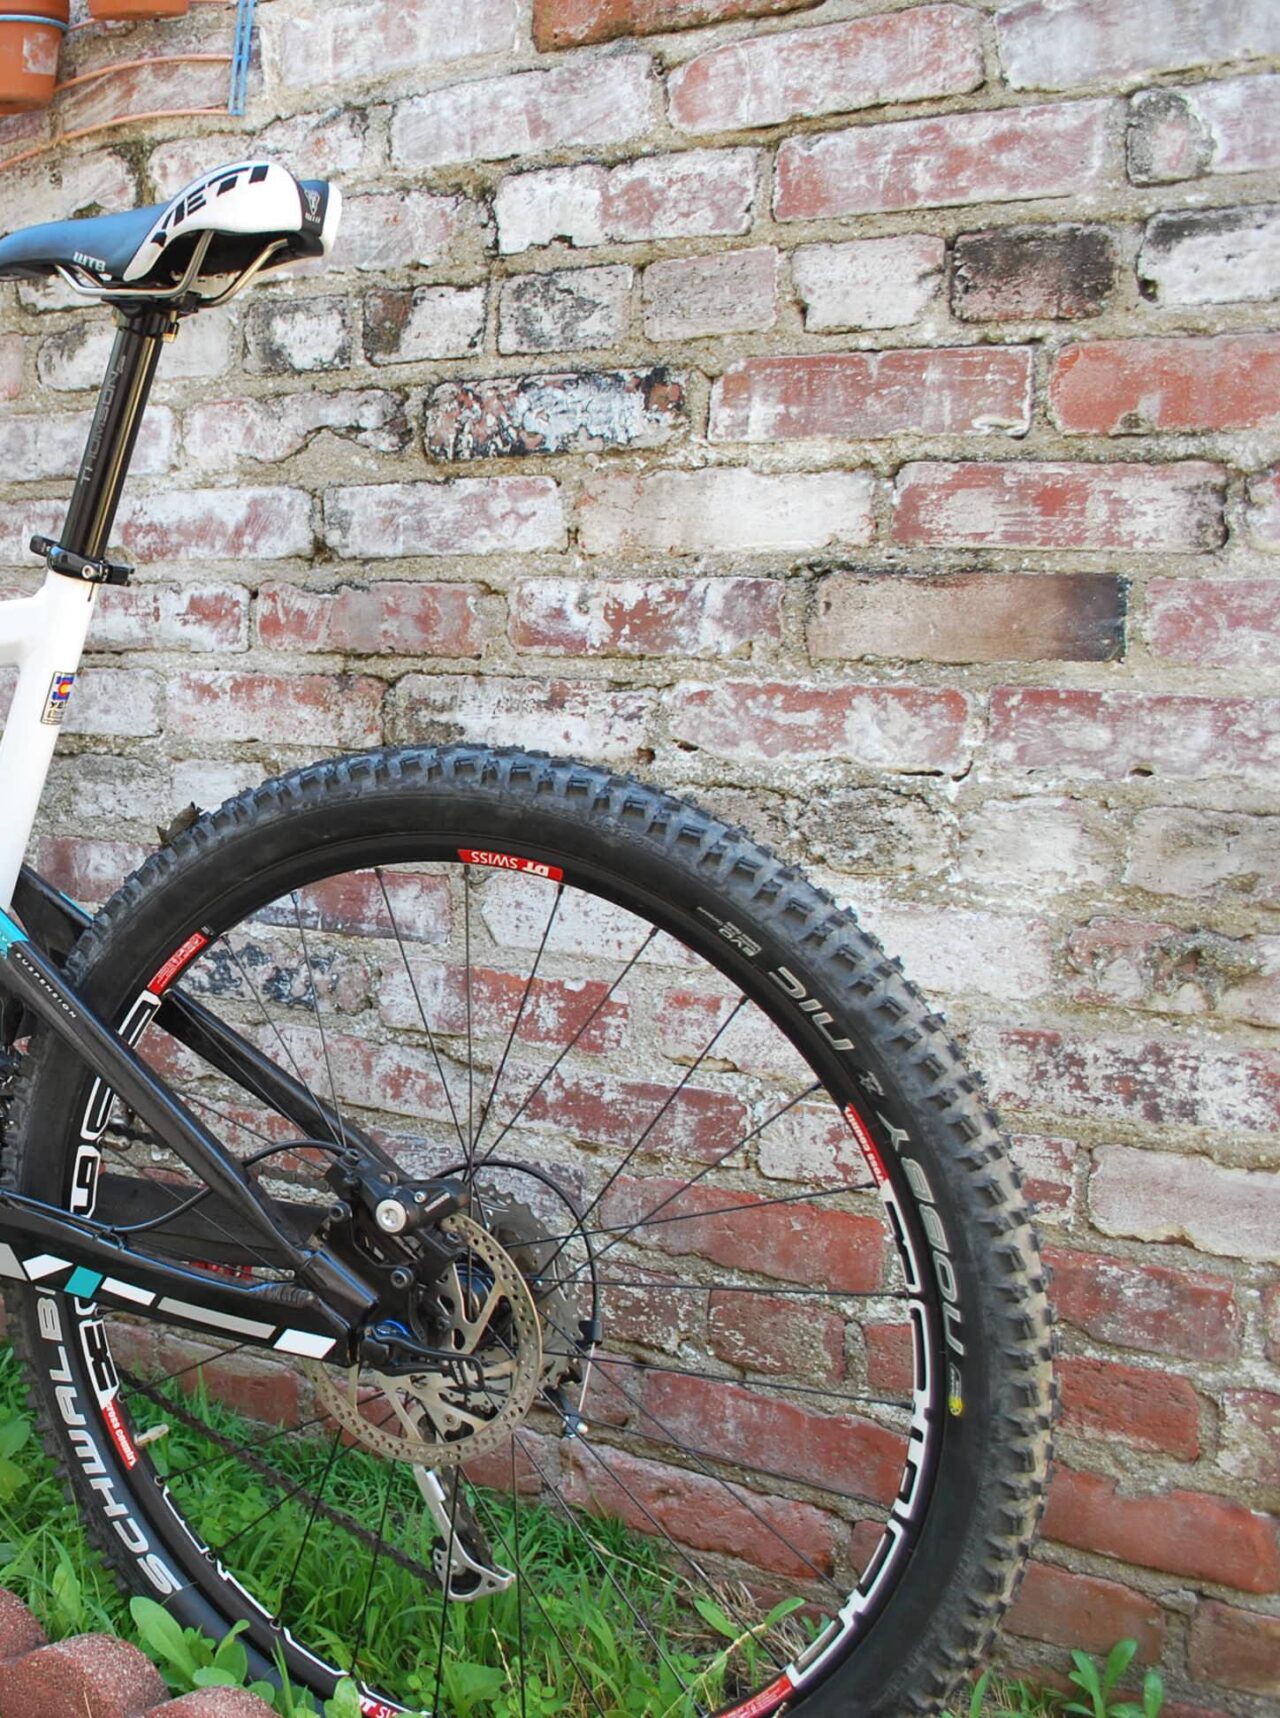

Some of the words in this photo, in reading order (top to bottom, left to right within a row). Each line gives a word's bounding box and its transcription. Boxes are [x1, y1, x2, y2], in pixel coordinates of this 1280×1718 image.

[73, 251, 107, 273] WTB
[470, 850, 519, 869] SWISS
[521, 861, 550, 877] DT
[718, 927, 755, 957] EVO
[15, 951, 77, 1019] SUSPENSION
[767, 966, 856, 1051] NIC
[875, 1110, 965, 1356] NOBBY
[35, 1284, 183, 1596] SCHWALB
